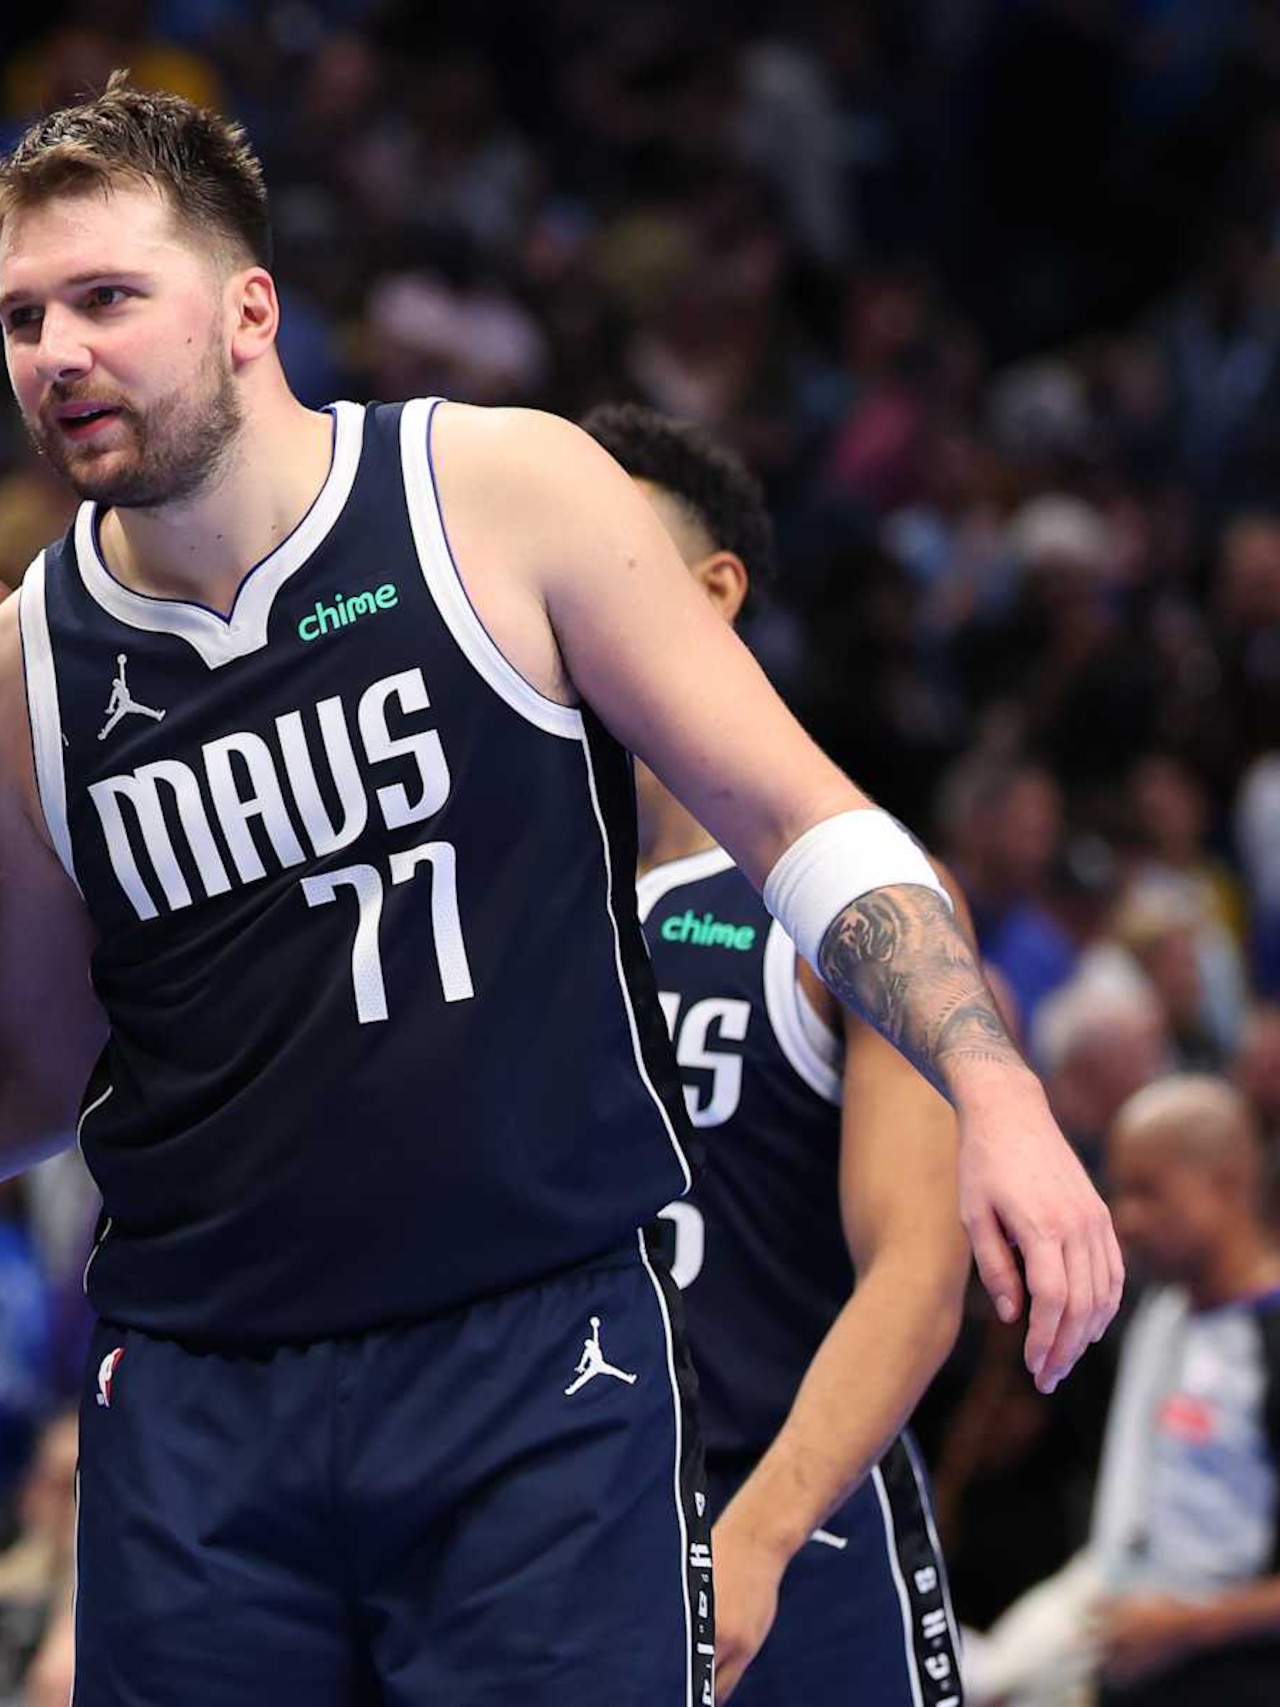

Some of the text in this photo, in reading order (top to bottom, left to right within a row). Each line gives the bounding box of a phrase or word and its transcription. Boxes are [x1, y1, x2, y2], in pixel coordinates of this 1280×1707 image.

[298, 583, 398, 642] chime
[87, 667, 451, 921] MAVS
[300, 841, 475, 1024] 77
[660, 910, 757, 951] chime
